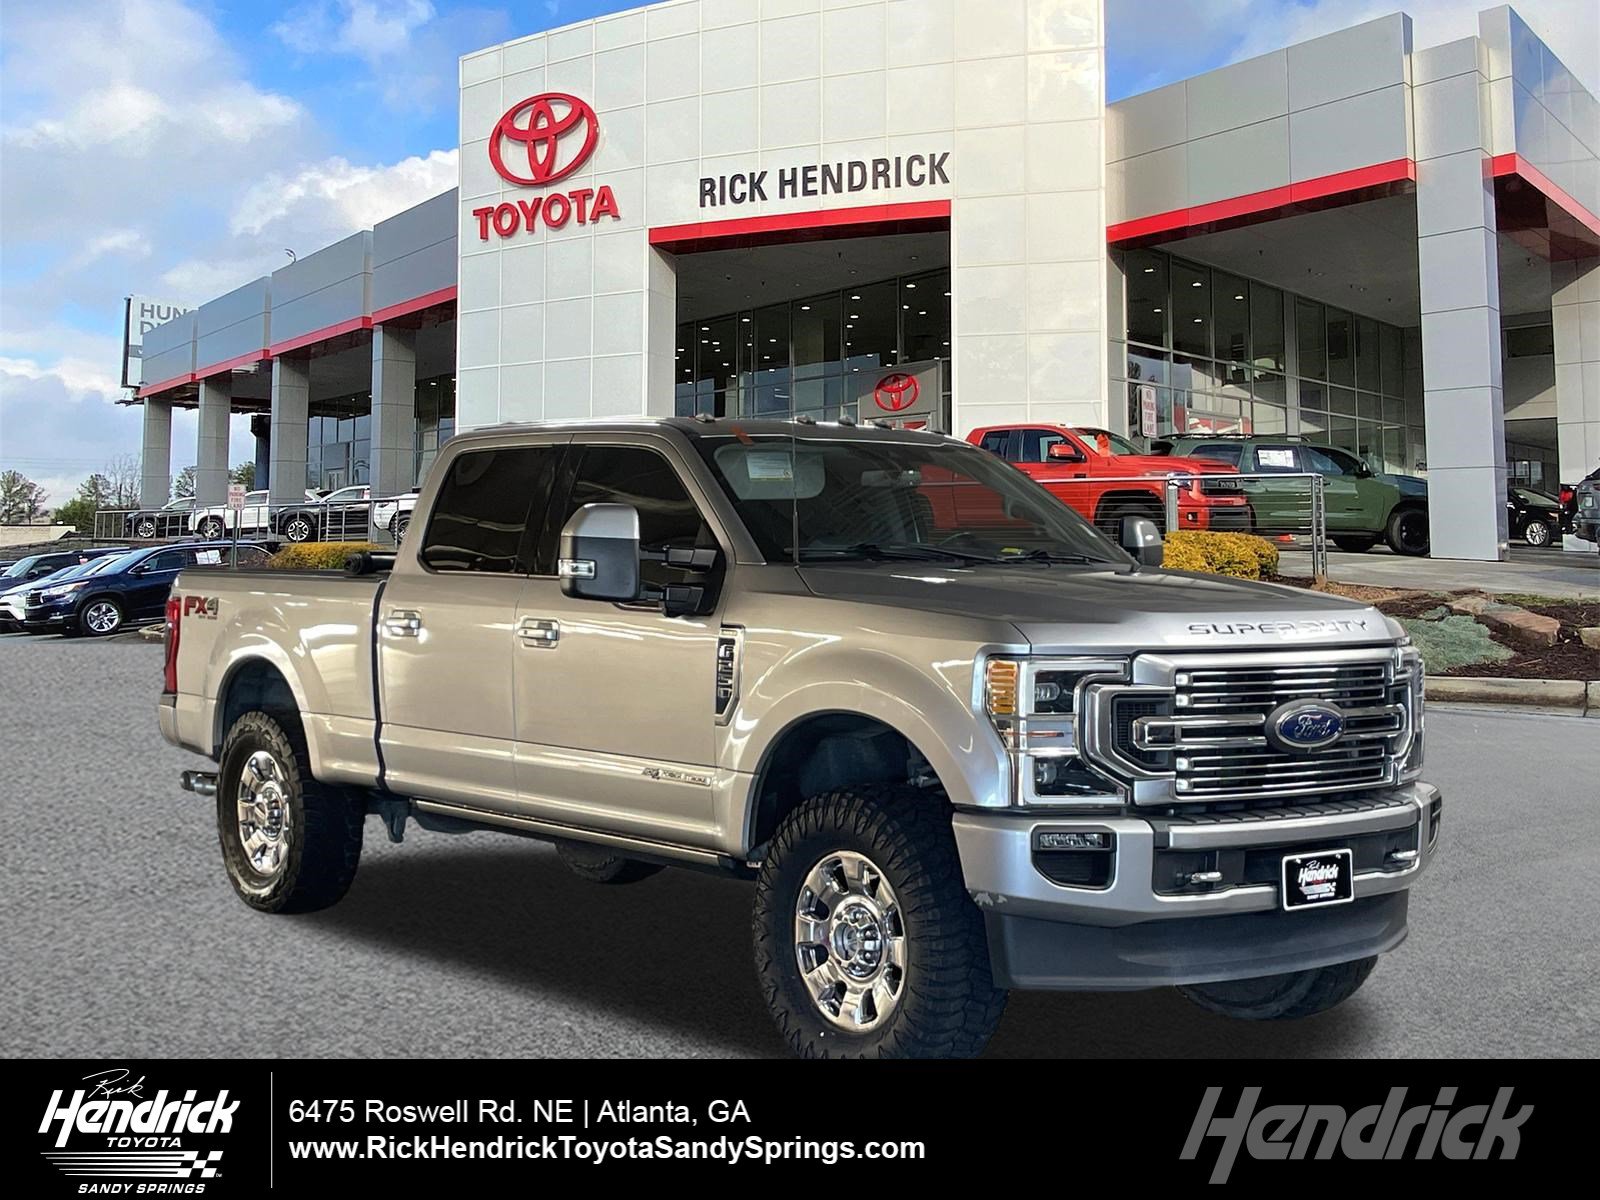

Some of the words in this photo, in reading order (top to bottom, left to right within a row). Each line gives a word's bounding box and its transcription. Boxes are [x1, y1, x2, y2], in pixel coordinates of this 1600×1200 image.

[699, 170, 768, 208] RICK
[778, 152, 951, 200] HENDRICK
[472, 185, 621, 240] TOYOTA
[183, 595, 219, 617] FX4
[1188, 622, 1297, 636] SUPER
[1301, 619, 1368, 633] DUTY
[1294, 714, 1332, 738] Ford
